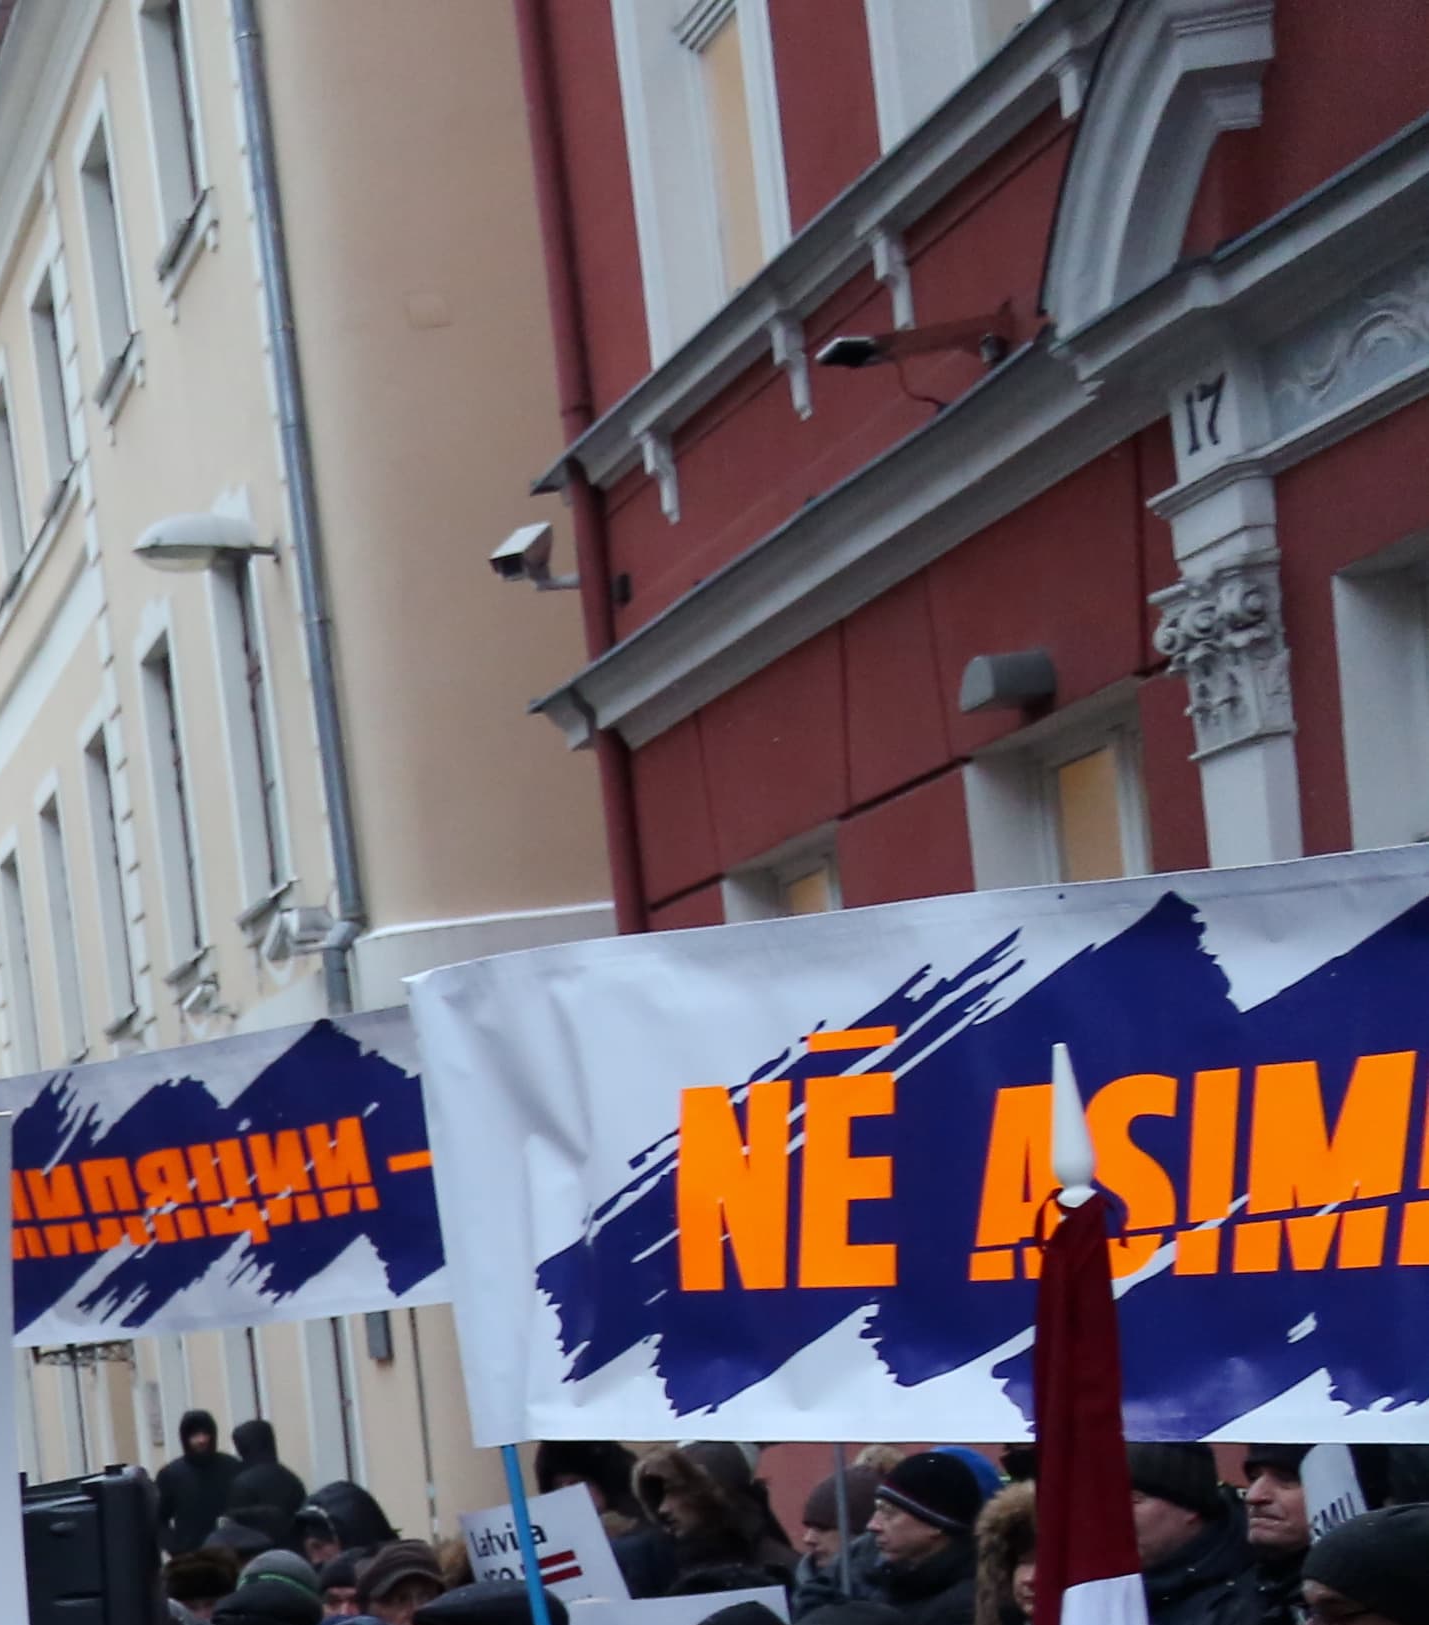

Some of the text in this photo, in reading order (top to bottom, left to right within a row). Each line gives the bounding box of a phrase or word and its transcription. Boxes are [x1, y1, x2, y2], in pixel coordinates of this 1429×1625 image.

[1183, 371, 1228, 456] 17
[677, 1026, 1429, 1292] NĒ ASIM
